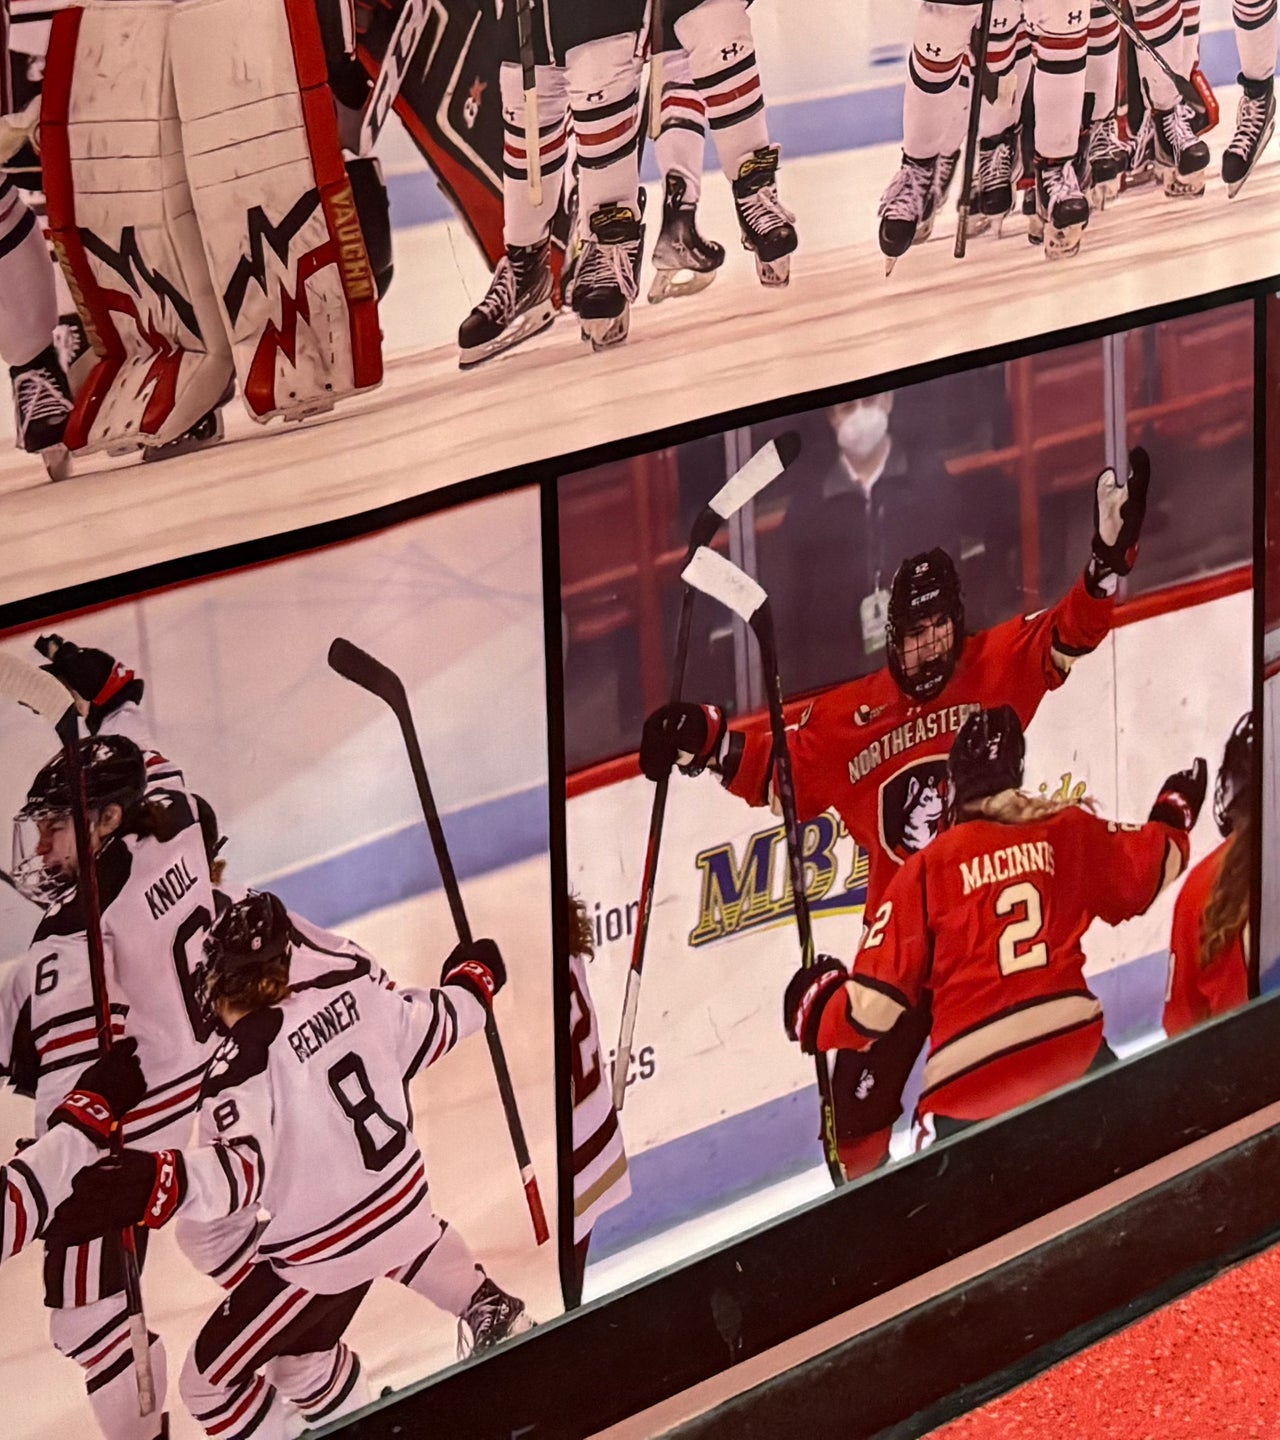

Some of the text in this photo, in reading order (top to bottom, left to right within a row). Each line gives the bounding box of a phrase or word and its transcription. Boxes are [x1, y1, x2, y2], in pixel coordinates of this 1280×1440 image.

[329, 183, 372, 300] VAUGHN
[144, 856, 198, 921] KNOLL
[864, 901, 893, 949] 2
[996, 882, 1048, 977] 2
[35, 953, 59, 996] 6
[287, 990, 360, 1063] RENNER
[213, 1099, 239, 1132] 8
[327, 1051, 407, 1172] 8
